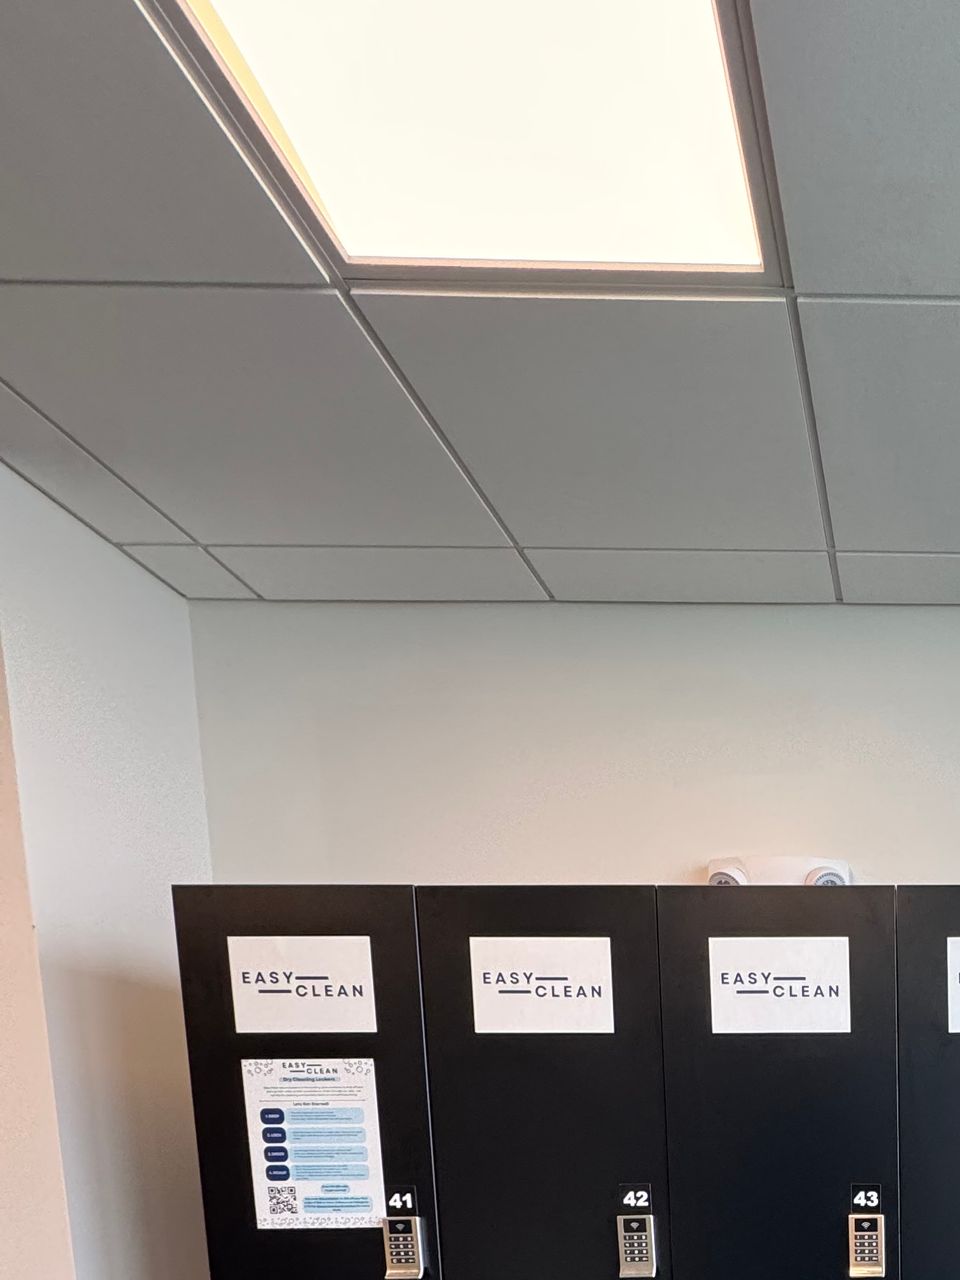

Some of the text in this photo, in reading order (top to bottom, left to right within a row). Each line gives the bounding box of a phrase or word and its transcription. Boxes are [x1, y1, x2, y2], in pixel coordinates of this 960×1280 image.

[241, 971, 293, 984] EASY
[482, 972, 533, 985] EASY
[720, 972, 771, 985] EASY
[295, 984, 364, 997] CLEAN
[535, 985, 602, 998] CLEAN
[772, 985, 839, 998] CLEAN
[389, 1193, 412, 1209] 41
[623, 1191, 648, 1207] 42
[854, 1191, 879, 1207] 43
